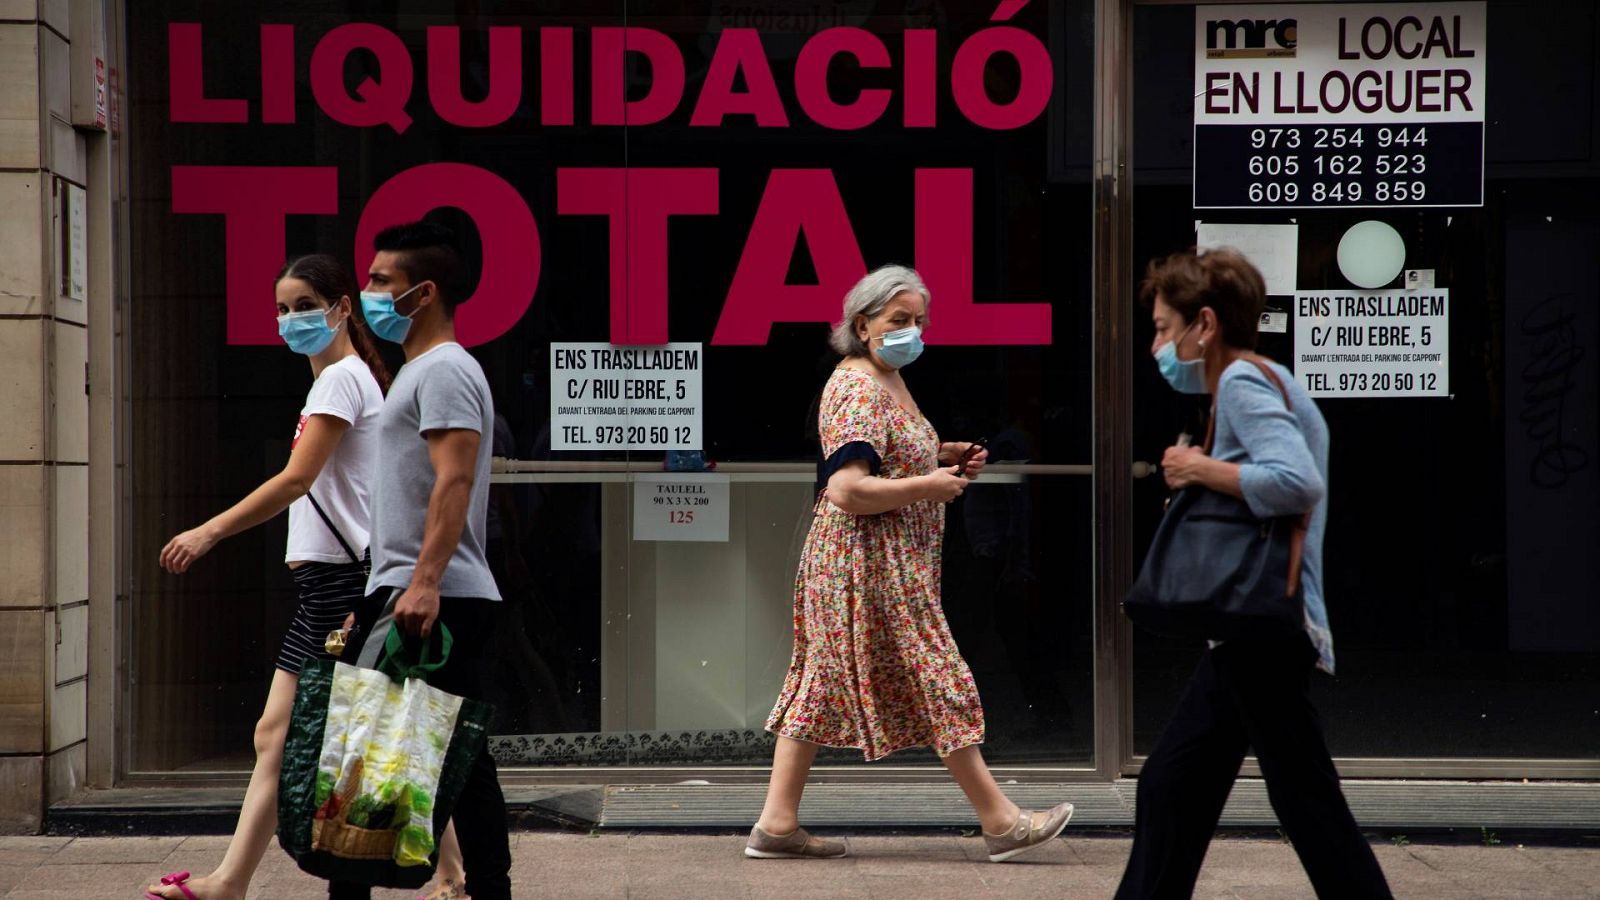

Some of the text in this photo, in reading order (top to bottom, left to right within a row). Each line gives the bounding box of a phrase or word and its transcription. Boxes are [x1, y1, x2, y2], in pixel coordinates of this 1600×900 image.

[1338, 15, 1475, 60] LOCAL
[168, 0, 1054, 134] LIQUIDACIÓ
[1205, 69, 1474, 114] EN LLOGUER
[1251, 128, 1428, 148] 973 254 944
[1249, 155, 1426, 175] 605 162 523
[1249, 182, 1426, 202] 609 849 859
[171, 163, 1053, 347] TOTAL
[1299, 296, 1445, 317] ENS TRASLLADEM
[1311, 326, 1431, 348] C/ RIU EBRE, 5
[555, 349, 698, 370] ENS TRASLLADEM
[1301, 353, 1441, 363] DAVANT L'ENTRADA DEL PARKING DE CAPPONT
[568, 379, 686, 402] C/ RIU EBRE, 5
[1306, 373, 1437, 391] TEL. 973 20 50 12
[558, 407, 695, 415] DAVANT L'ENTRADA DEL PARKING DE CAPPONT
[562, 426, 691, 444] TEL. 973 20 50 12
[656, 485, 706, 494] TAULELL
[675, 497, 681, 505] 3
[684, 497, 691, 505] X
[694, 497, 709, 505] 200
[670, 511, 693, 524] 125
